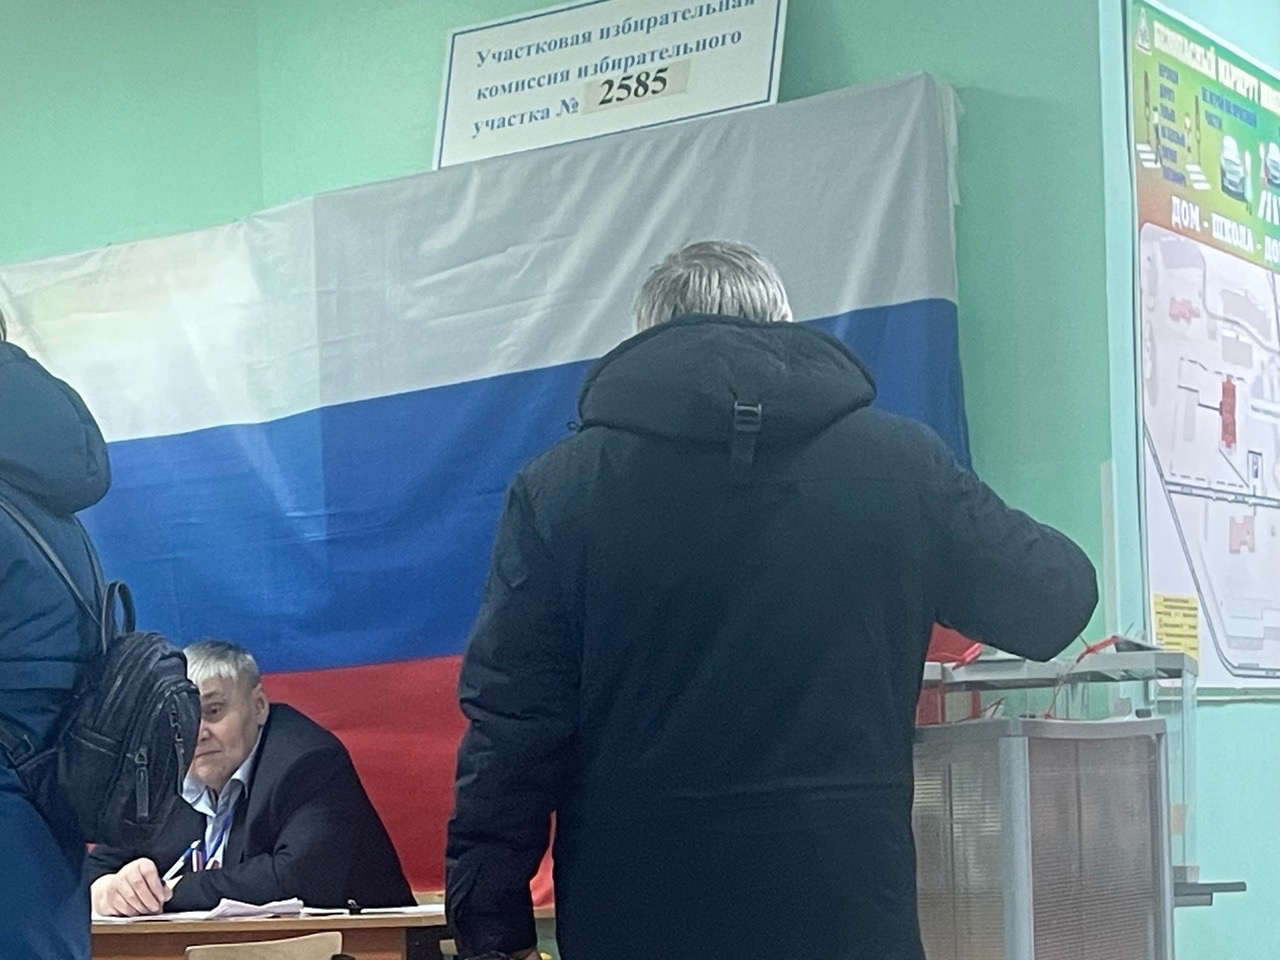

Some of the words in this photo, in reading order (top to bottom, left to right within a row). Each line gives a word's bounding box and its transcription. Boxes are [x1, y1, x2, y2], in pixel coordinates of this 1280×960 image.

[476, 31, 592, 67] Участковая
[476, 69, 571, 101] комиссия
[577, 30, 742, 79] избирательного
[471, 107, 551, 139] участка
[555, 97, 580, 117] №
[598, 67, 670, 106] 2585
[1172, 195, 1201, 232] ДОМ
[1212, 212, 1254, 253] ШКОЛА
[1264, 235, 1280, 264] ДО
